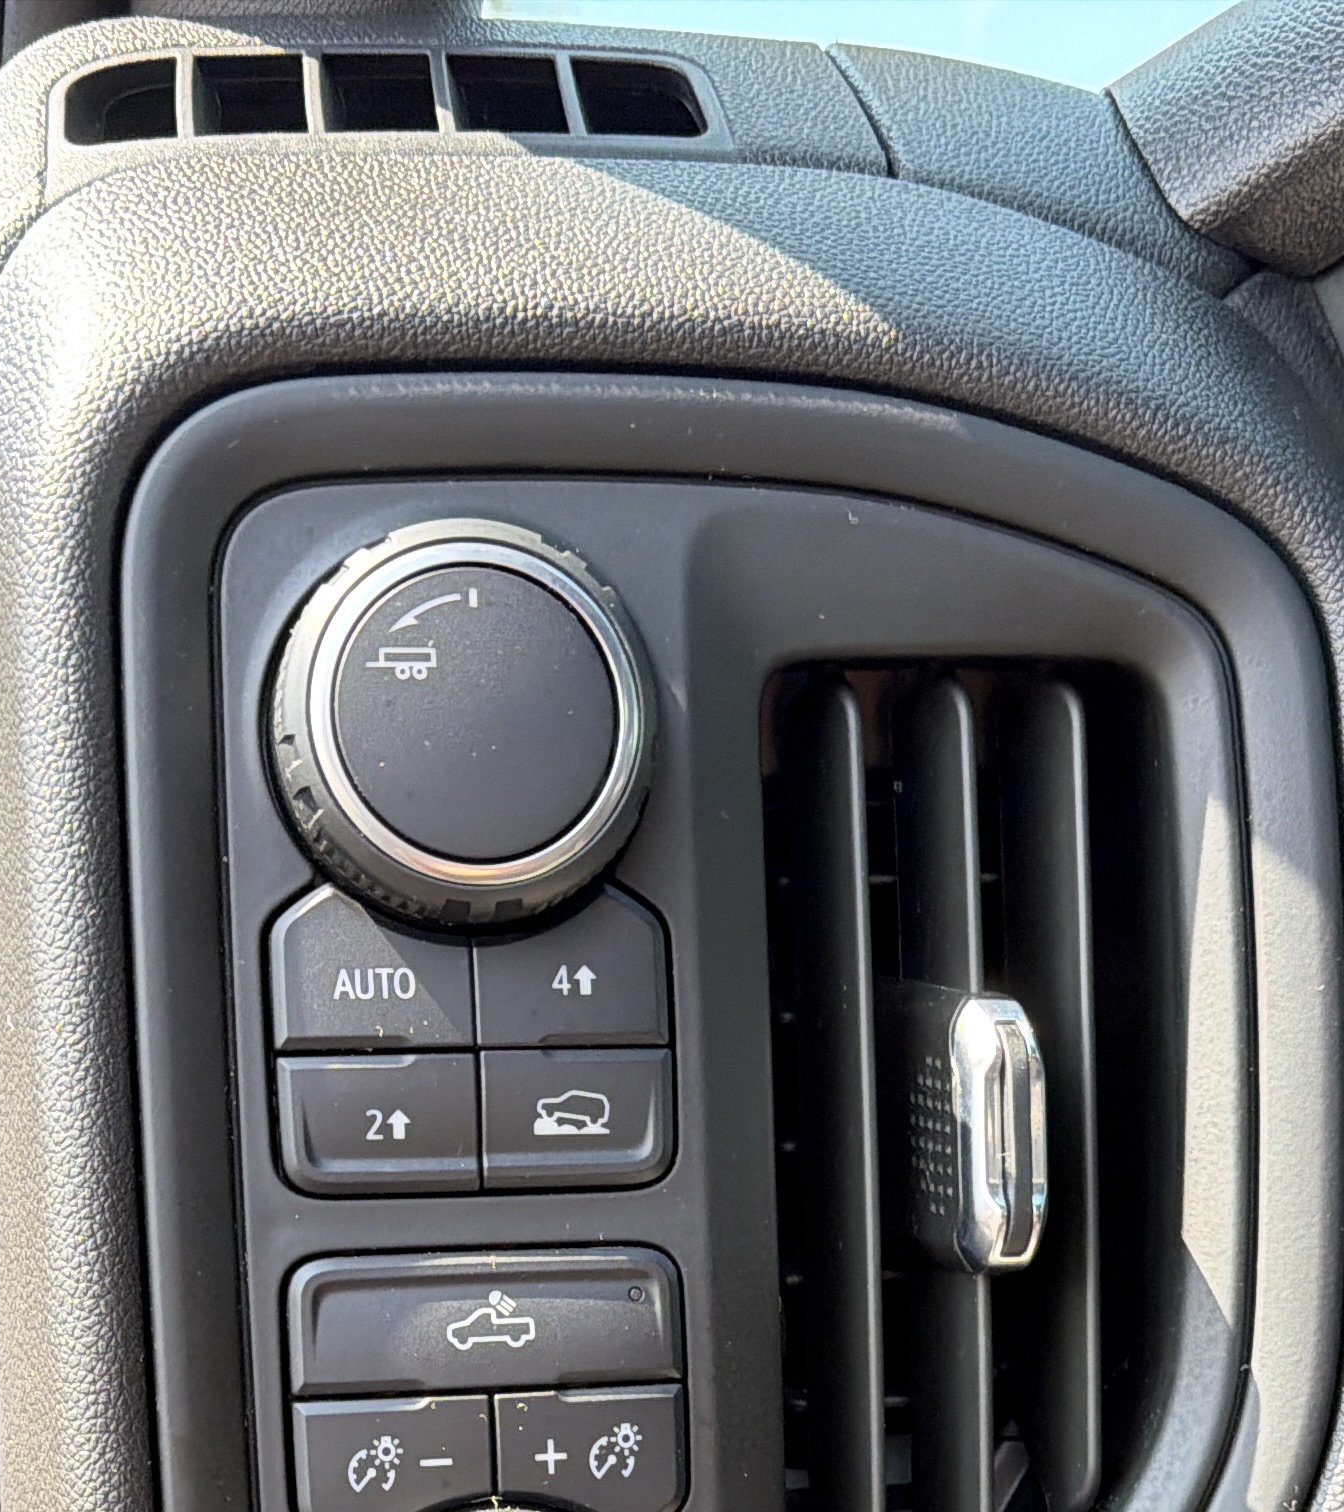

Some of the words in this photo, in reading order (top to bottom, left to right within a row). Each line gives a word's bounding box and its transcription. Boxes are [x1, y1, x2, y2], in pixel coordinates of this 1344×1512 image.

[333, 967, 417, 1000] AUTO
[551, 964, 572, 996] 4
[365, 1109, 385, 1141] 2
